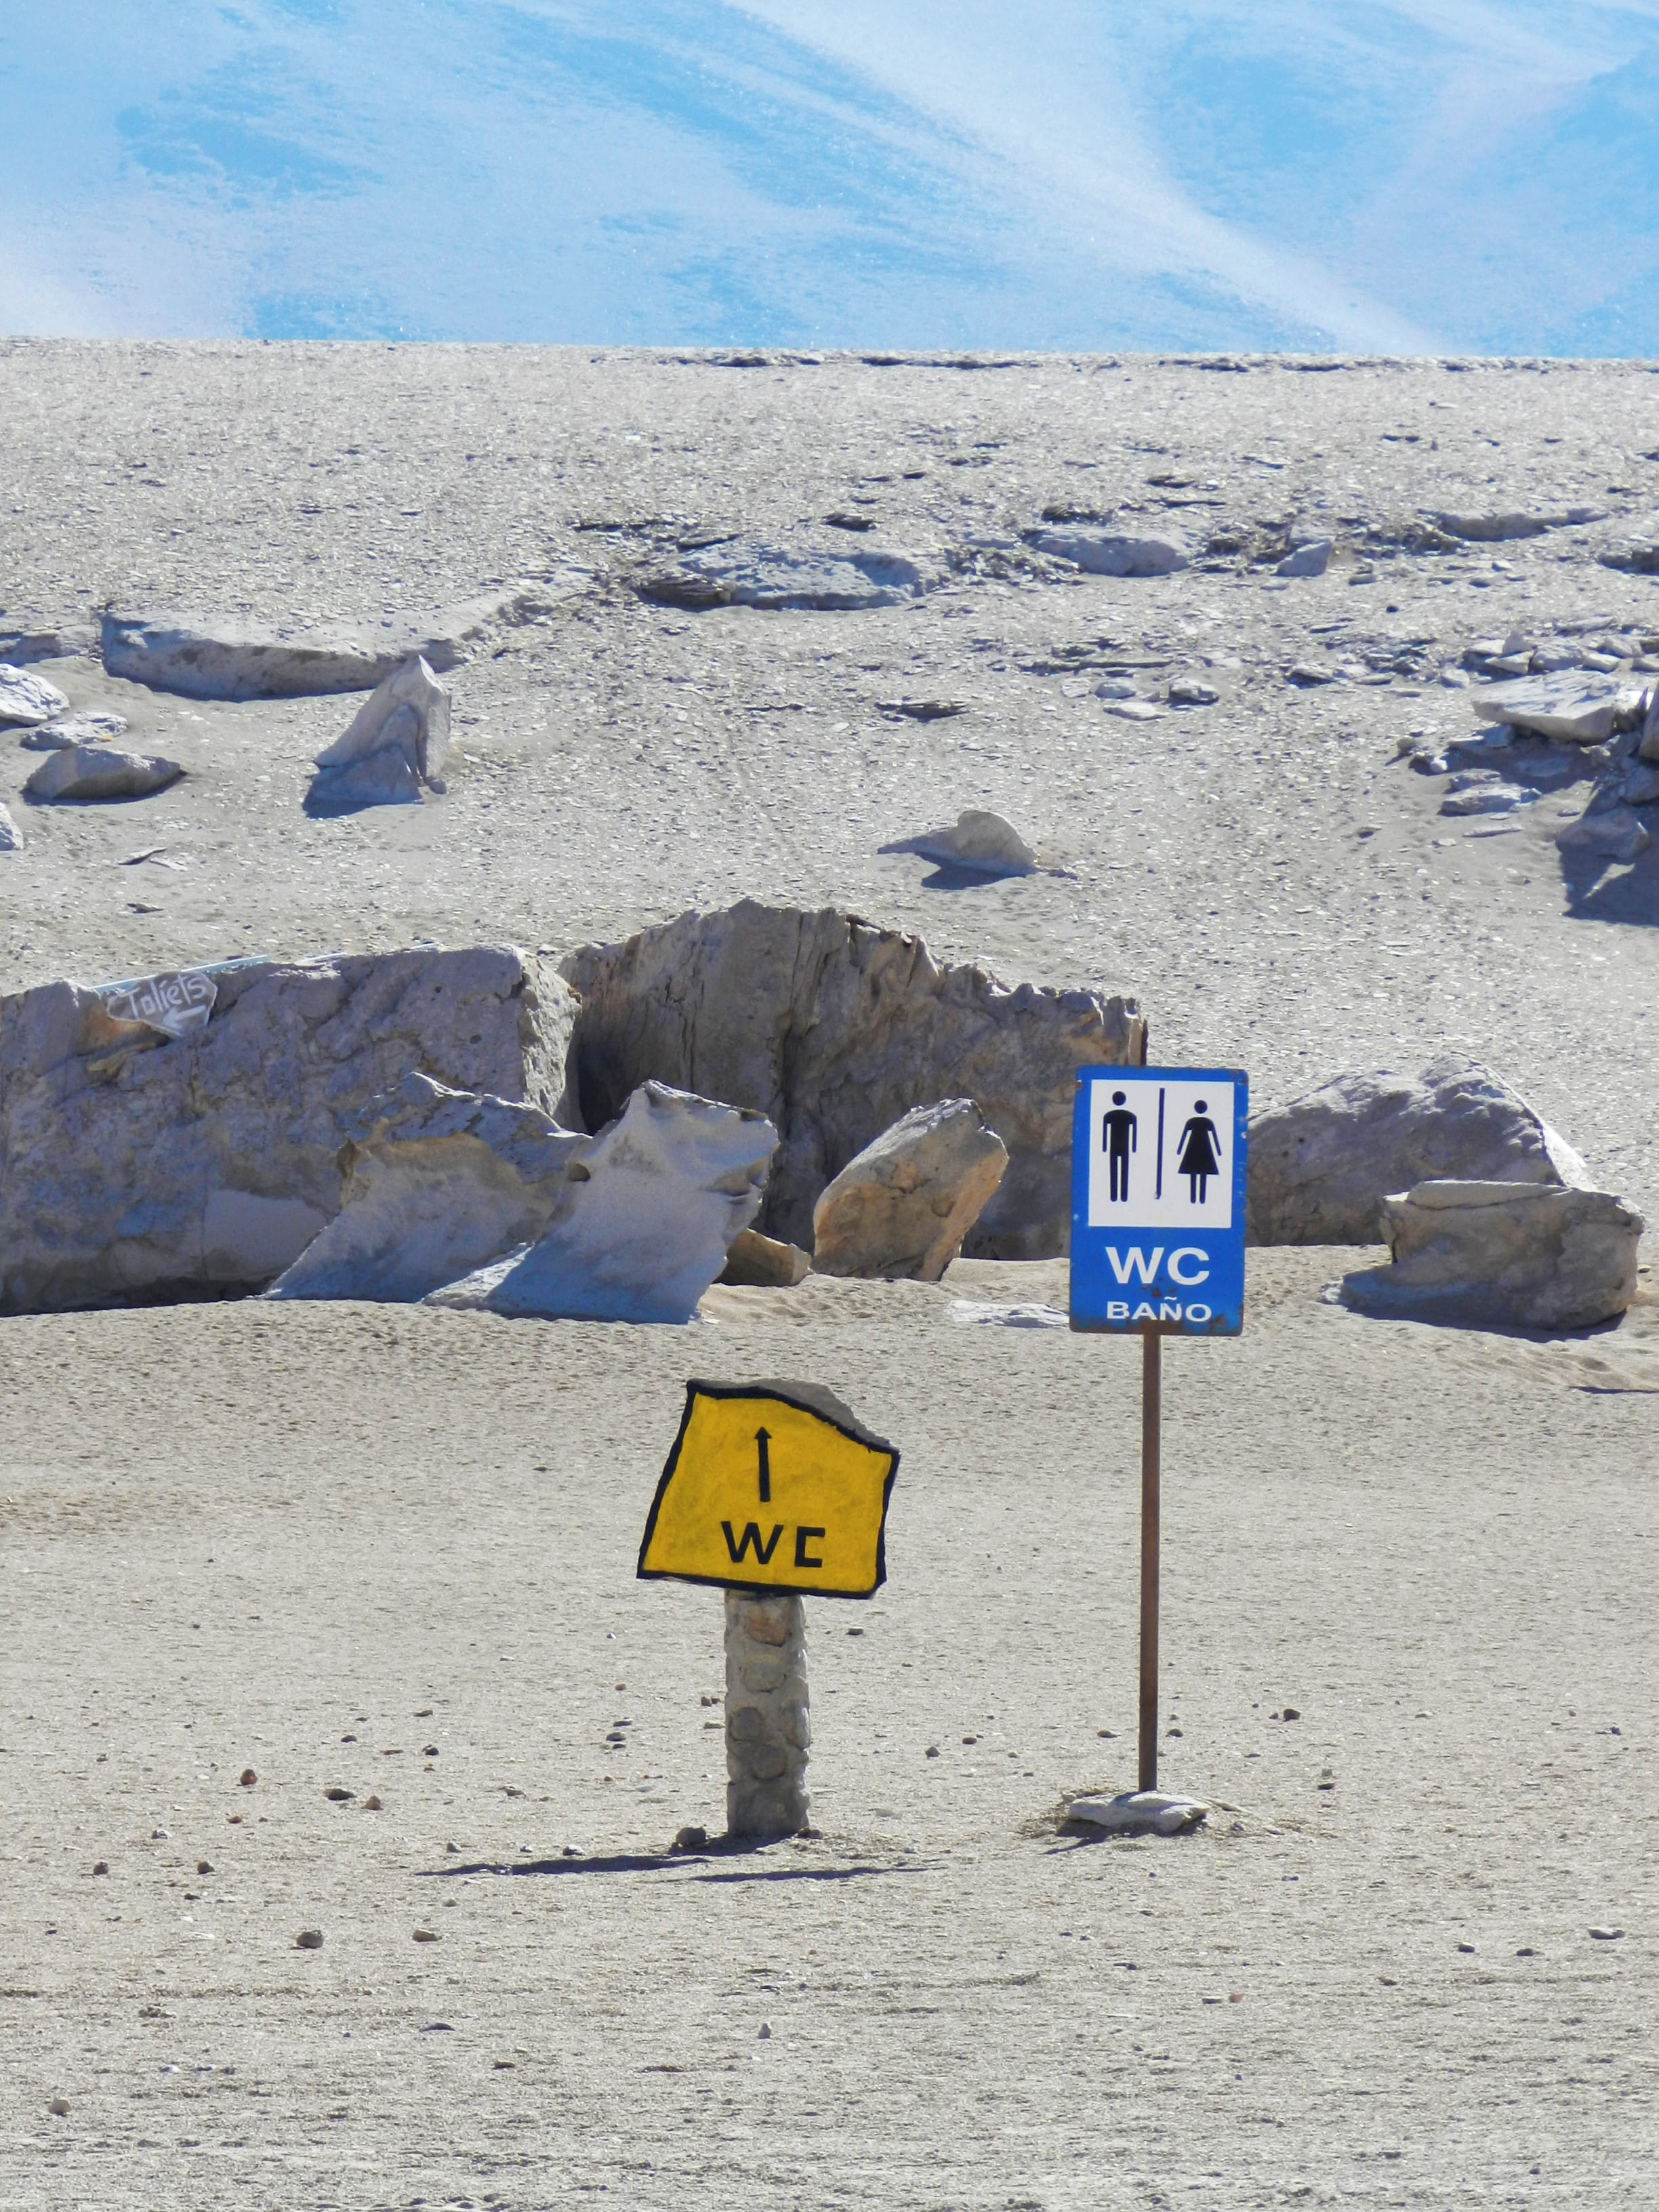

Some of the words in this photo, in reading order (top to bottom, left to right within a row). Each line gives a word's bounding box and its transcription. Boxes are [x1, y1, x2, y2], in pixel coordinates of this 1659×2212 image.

[119, 974, 205, 1021] Toliets
[1105, 1246, 1210, 1286] WC
[1106, 1296, 1212, 1322] BAÑO
[720, 1520, 825, 1568] WC
